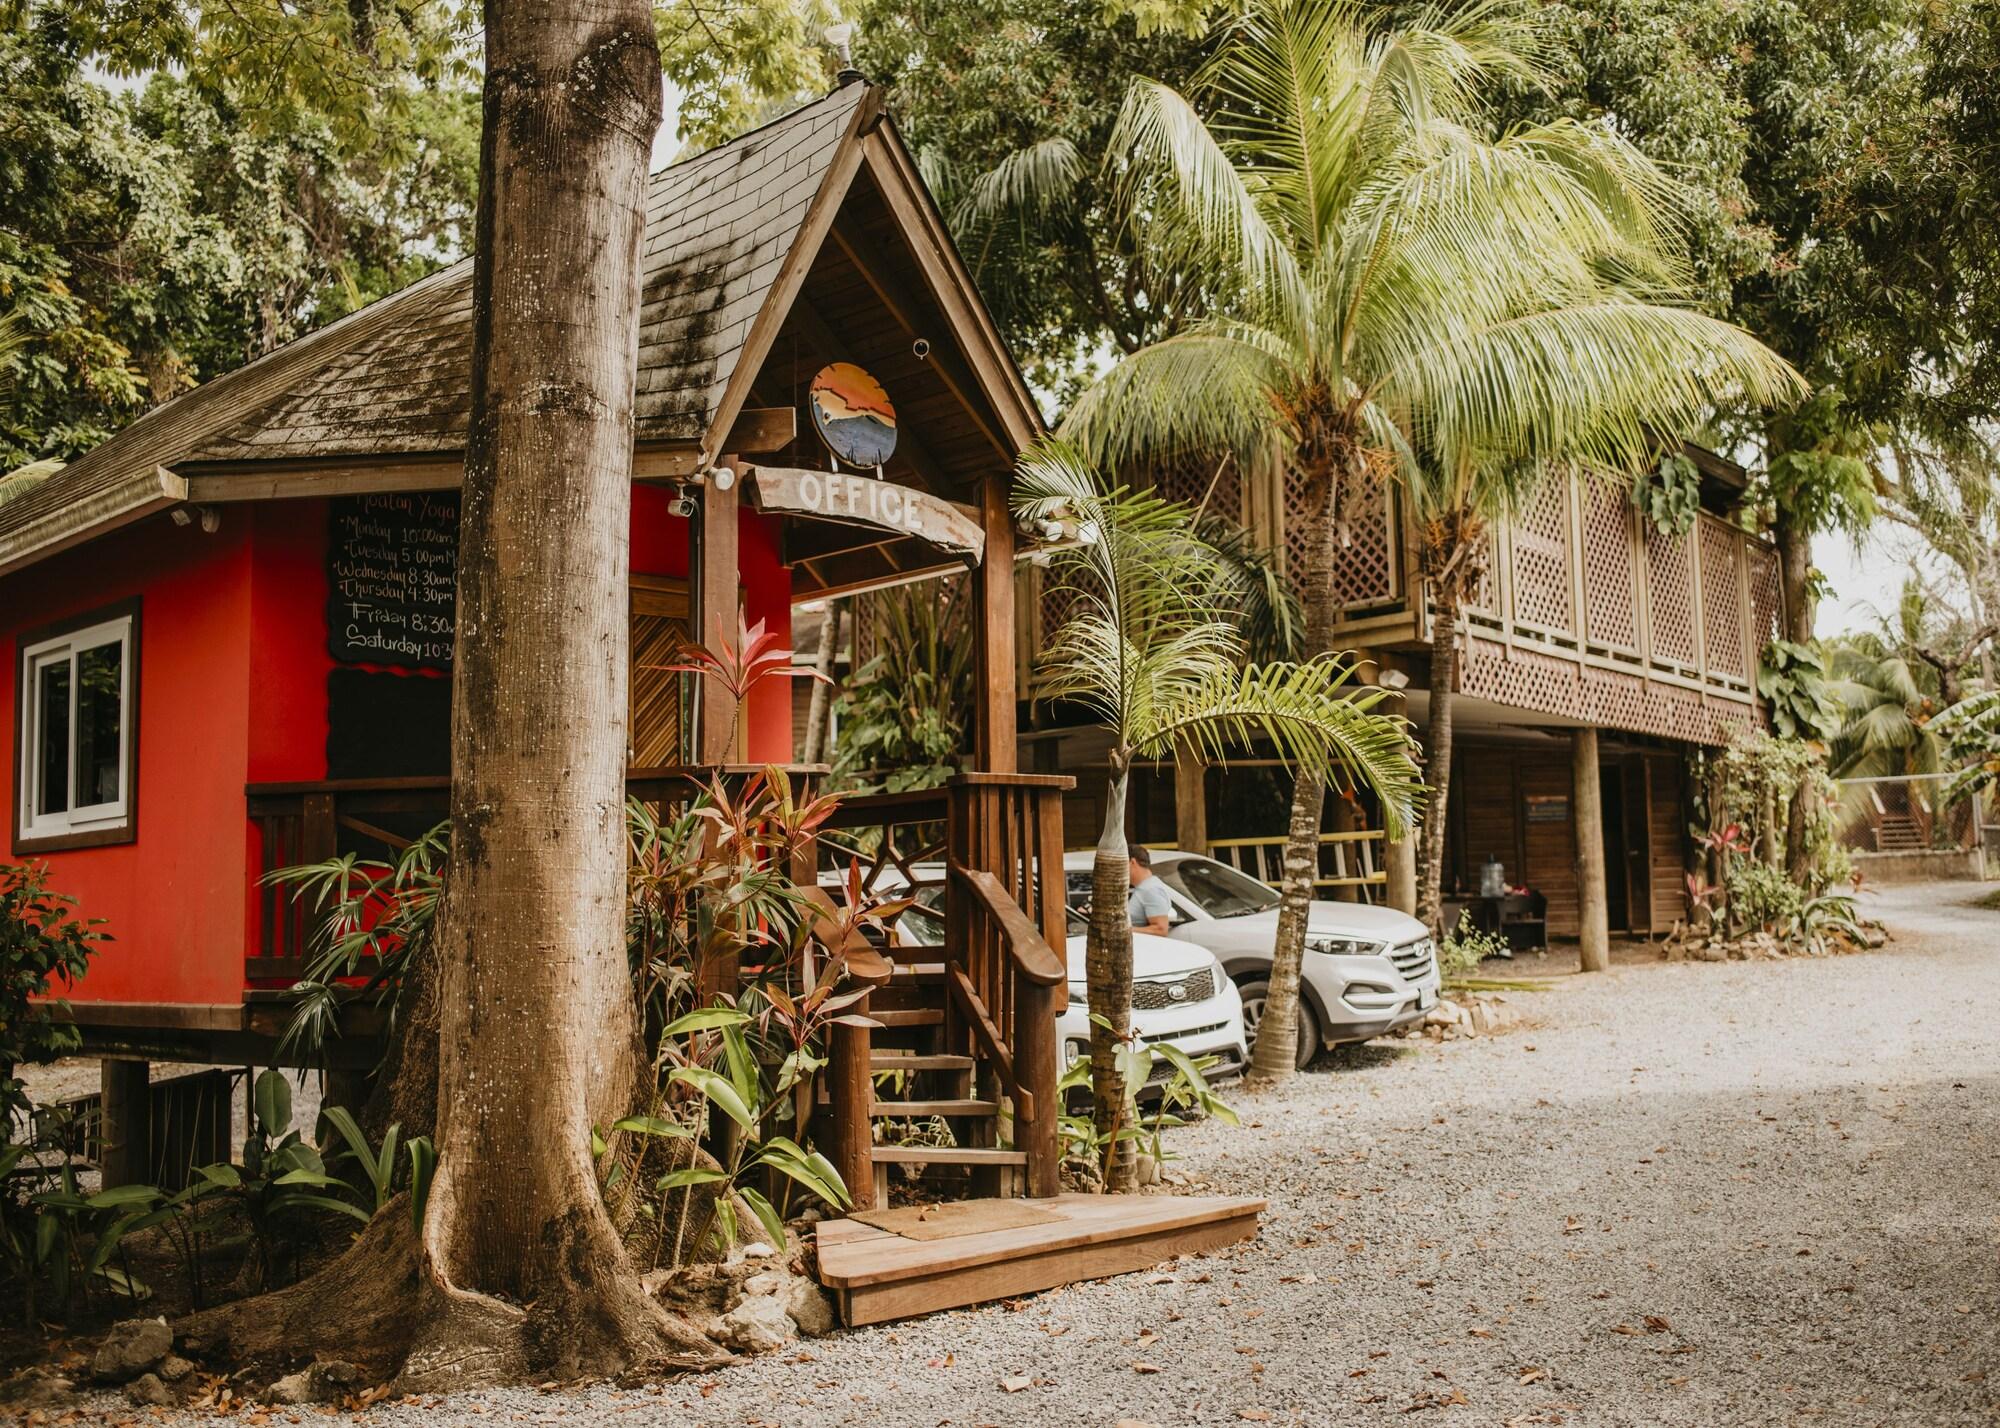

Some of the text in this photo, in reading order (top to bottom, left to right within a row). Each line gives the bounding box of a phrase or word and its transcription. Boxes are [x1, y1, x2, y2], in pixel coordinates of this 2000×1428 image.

[418, 495, 455, 527] Yoga
[800, 473, 922, 530] OFFICE
[346, 515, 391, 544] Monday
[402, 528, 453, 544] 10:00am
[344, 539, 398, 568] Tuesday
[337, 560, 406, 589] Wednesday
[408, 567, 451, 586] 8:30am
[337, 578, 453, 605] Thursday 4:30pm
[344, 601, 406, 629] Friday
[346, 623, 421, 661] Saturday
